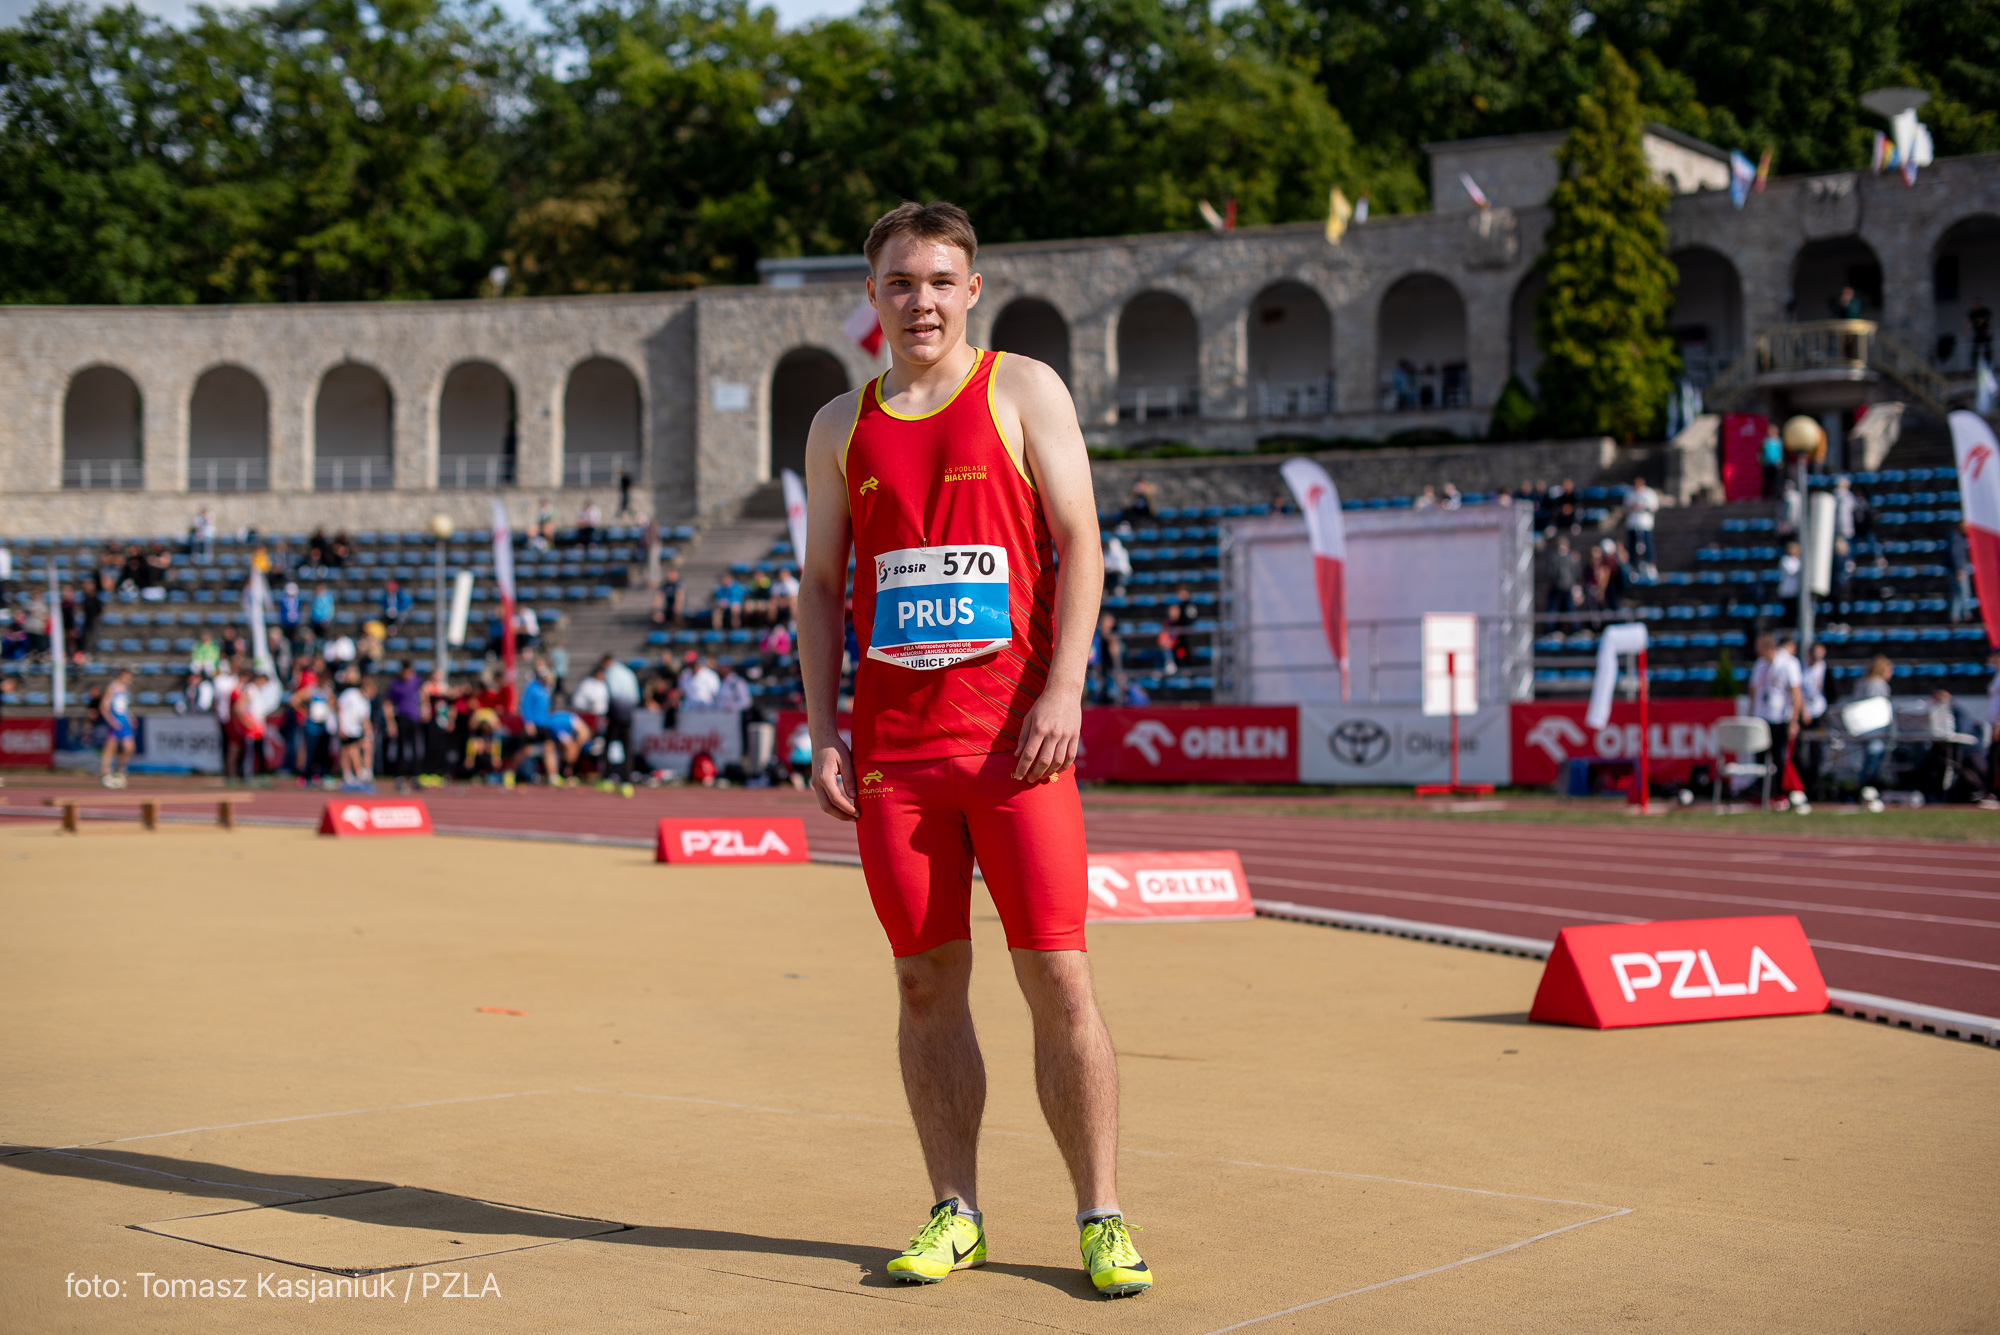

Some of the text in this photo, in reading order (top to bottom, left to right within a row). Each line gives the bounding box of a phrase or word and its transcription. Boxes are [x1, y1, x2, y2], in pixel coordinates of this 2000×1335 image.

[944, 472, 988, 482] BIAŁYSTOK
[954, 465, 988, 473] PODLASIE
[943, 551, 996, 576] 570
[898, 597, 975, 629] PRUS
[1180, 725, 1289, 760] ORLEN
[680, 829, 790, 857] PZLA
[1147, 877, 1228, 895] ORLEN
[1610, 945, 1798, 1002] PZLA
